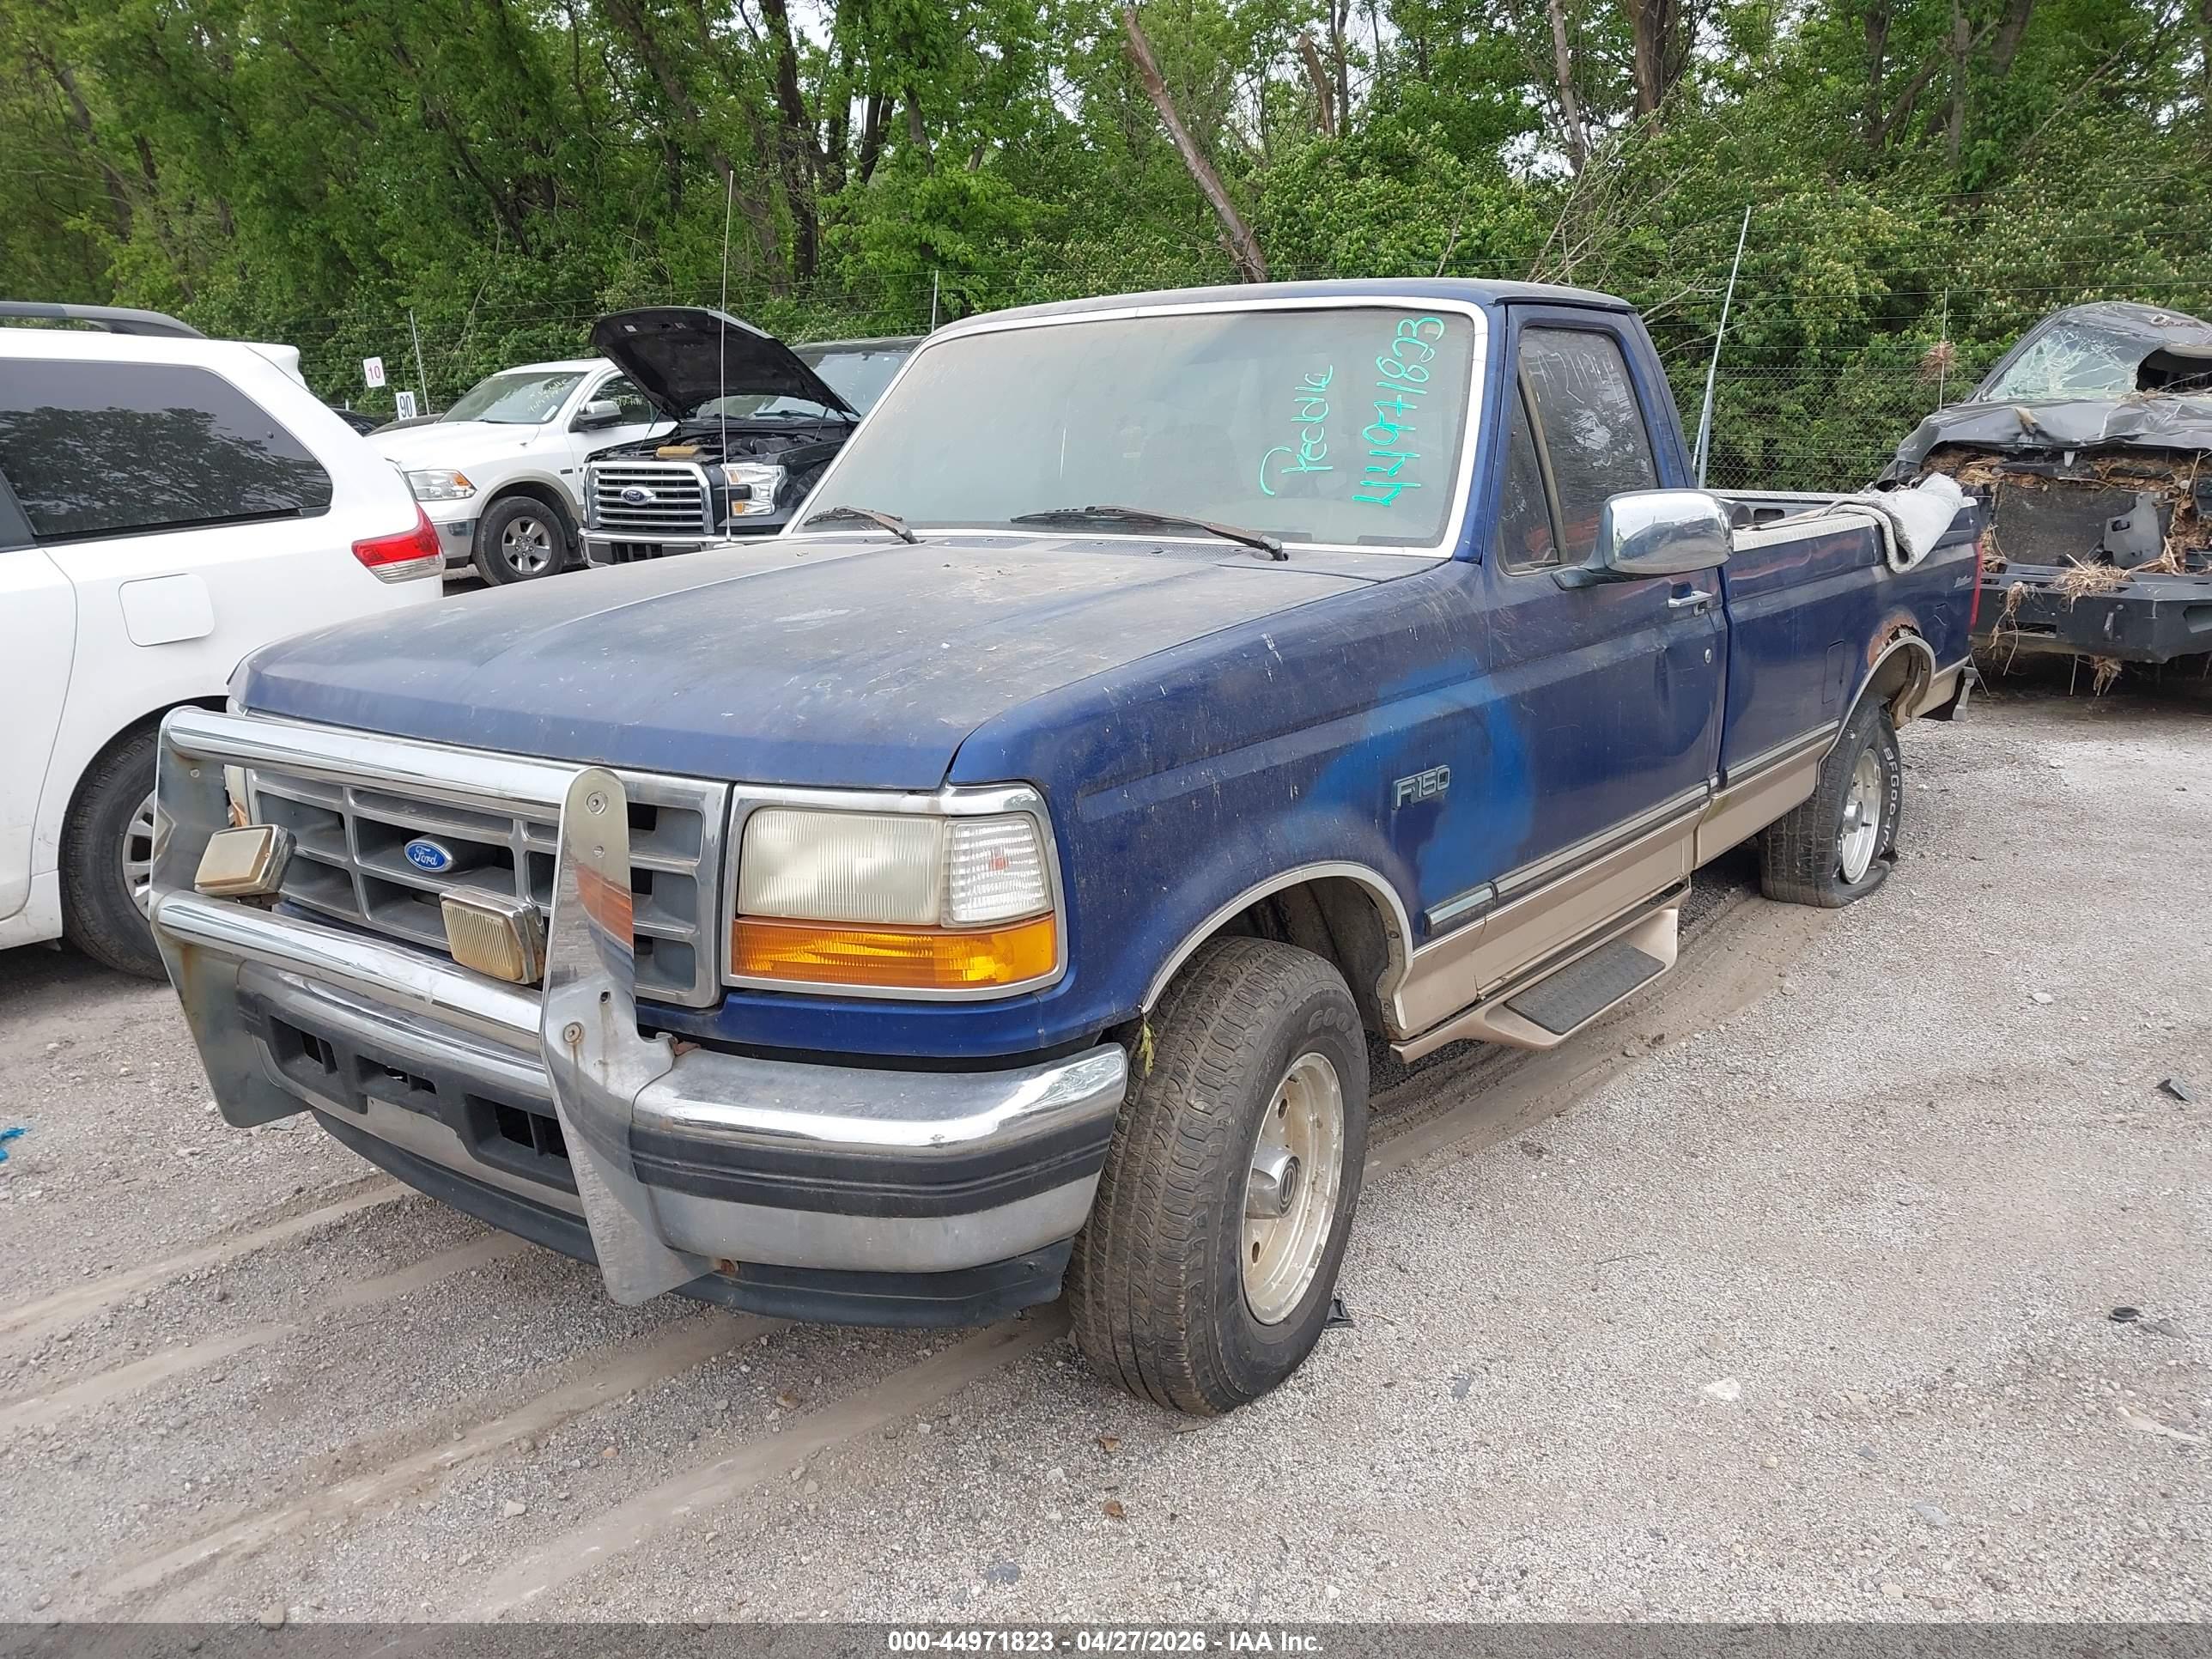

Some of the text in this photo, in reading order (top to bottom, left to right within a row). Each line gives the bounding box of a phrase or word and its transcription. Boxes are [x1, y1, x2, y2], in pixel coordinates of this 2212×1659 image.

[368, 365, 381, 380] 10
[399, 395, 413, 418] 90
[1351, 316, 1445, 507] 44971823
[413, 846, 438, 866] Ford
